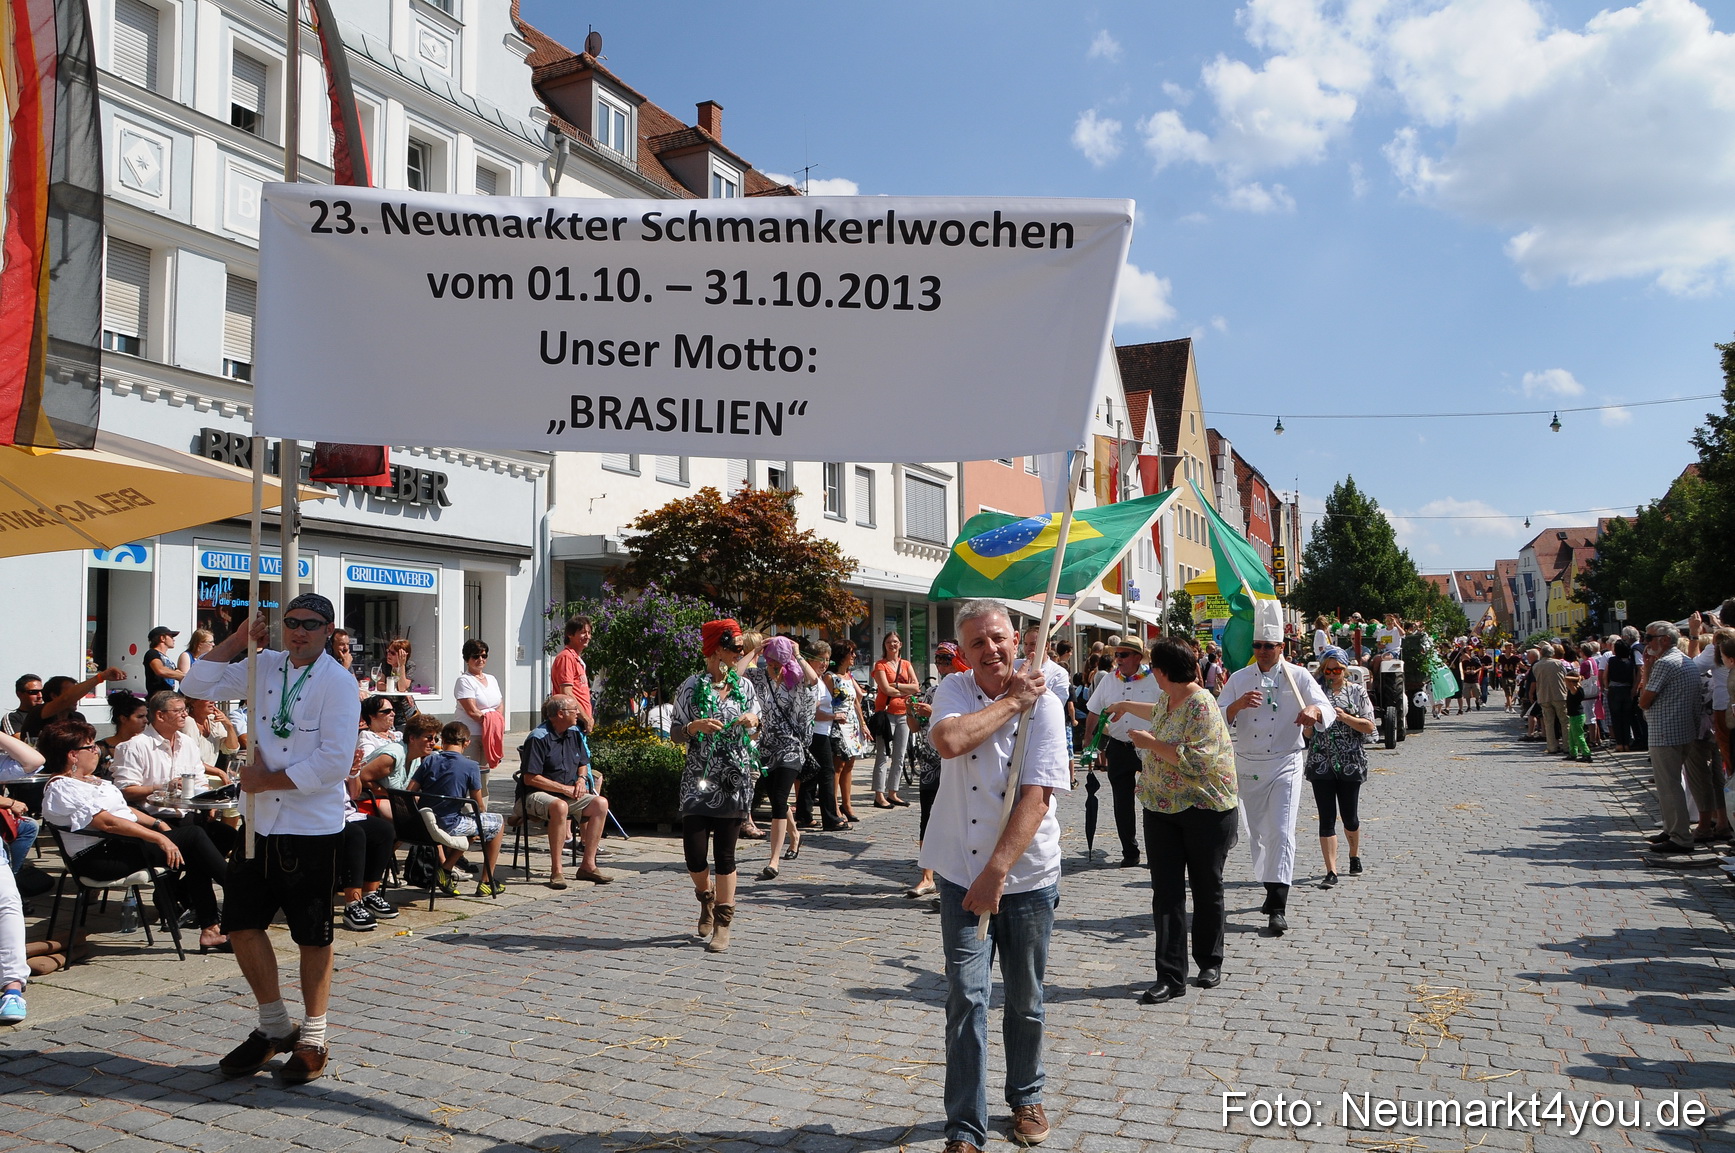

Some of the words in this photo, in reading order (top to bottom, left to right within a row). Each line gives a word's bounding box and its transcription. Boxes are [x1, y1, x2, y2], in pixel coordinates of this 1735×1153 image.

[310, 200, 369, 235] 23.
[381, 203, 628, 242] Neumarkter
[642, 209, 1074, 251] Schmankerlwochen
[427, 273, 514, 301] vom
[528, 266, 653, 303] 01.10.
[705, 270, 942, 312] 31.10.2013
[541, 331, 660, 368] Unser
[675, 334, 817, 374] Motto:
[547, 395, 809, 437] „BRASILIEN“
[261, 557, 305, 576] WER
[352, 566, 393, 583] BRILLEN
[395, 570, 430, 587] WEBER
[219, 598, 230, 606] die
[262, 599, 279, 608] Linie
